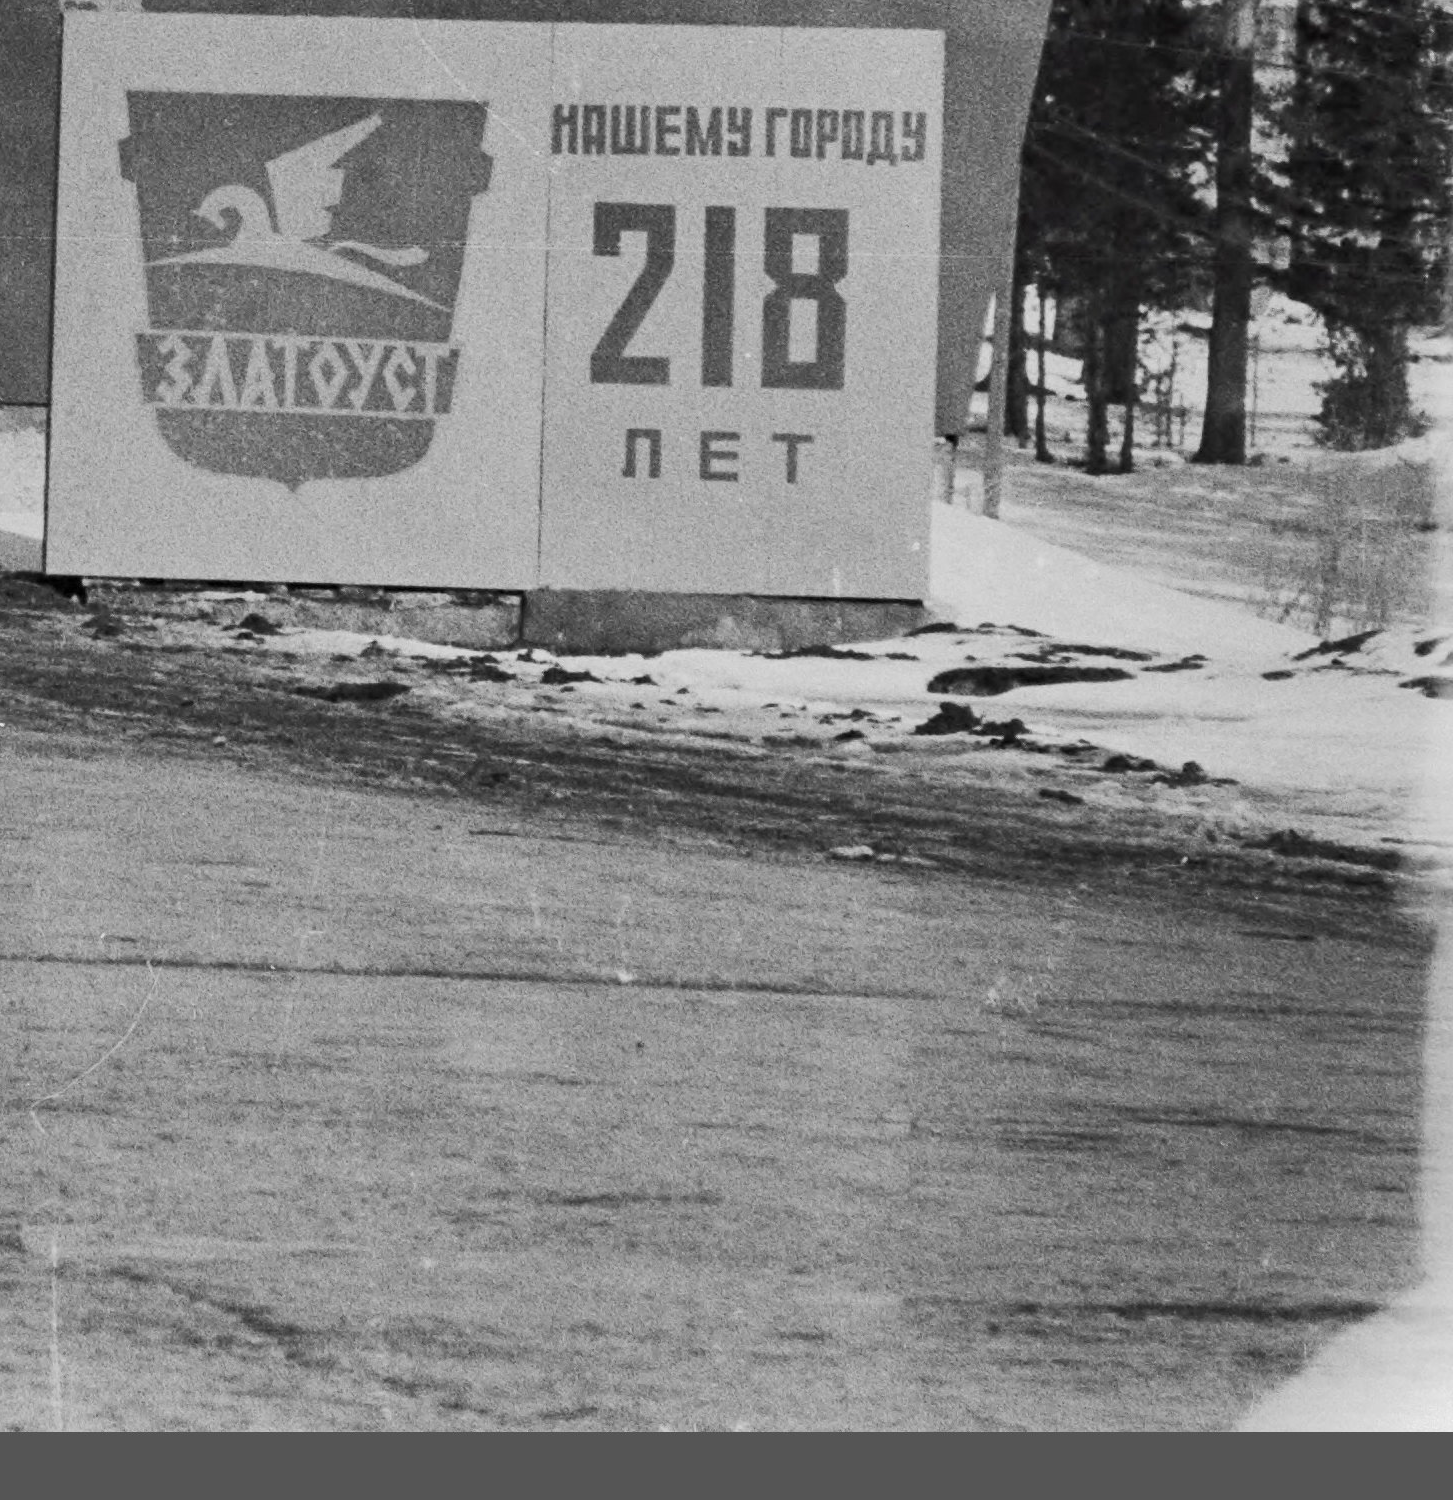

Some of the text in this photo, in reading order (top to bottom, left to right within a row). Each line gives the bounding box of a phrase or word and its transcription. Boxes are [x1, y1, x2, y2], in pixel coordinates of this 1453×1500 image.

[550, 104, 927, 165] НАШЕМУ ГОРОДУ
[591, 201, 849, 390] 218
[154, 334, 451, 412] ЗЛАТОУСТ
[622, 428, 815, 484] ЛЕТ
